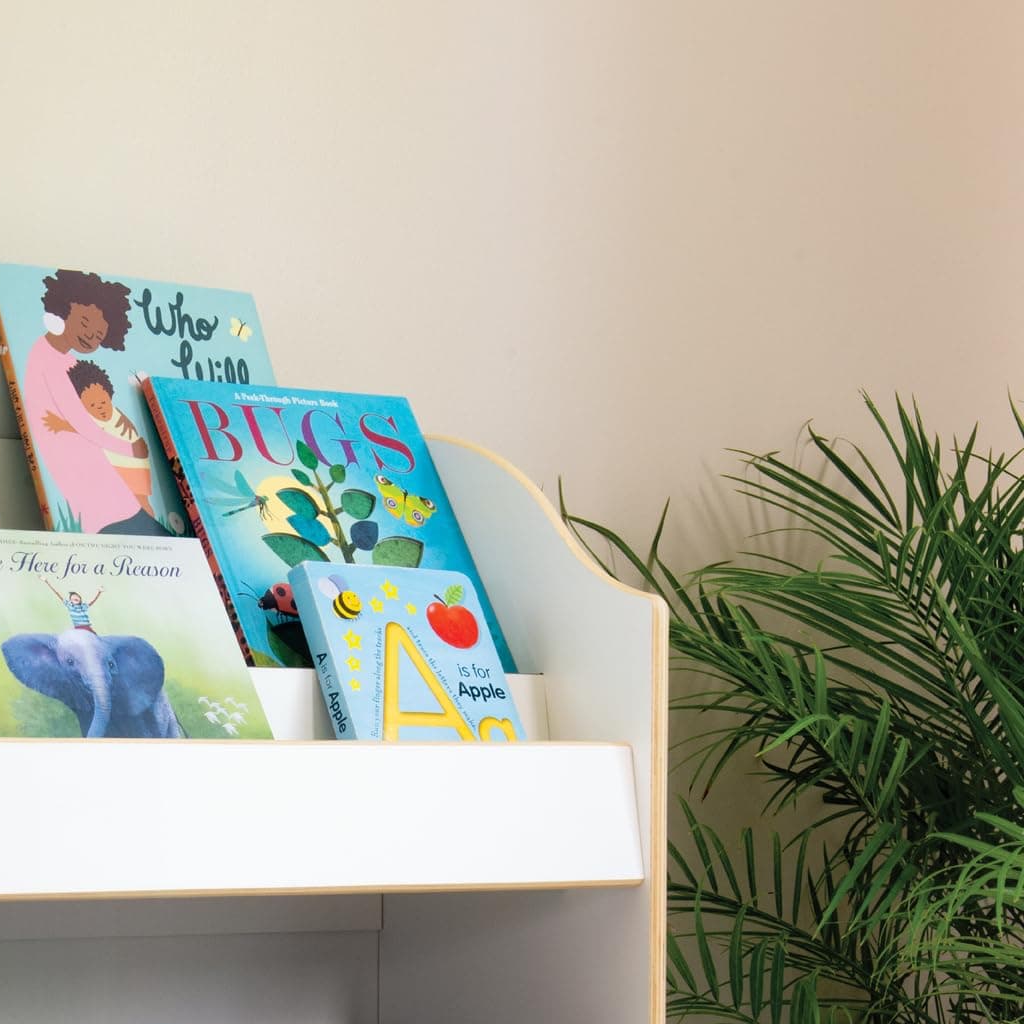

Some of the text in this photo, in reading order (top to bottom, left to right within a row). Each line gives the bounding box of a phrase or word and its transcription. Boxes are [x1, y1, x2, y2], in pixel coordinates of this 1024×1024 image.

[133, 288, 219, 341] Who
[170, 340, 250, 384] Will
[234, 392, 241, 400] A
[292, 396, 318, 407] Picture
[319, 399, 338, 408] Book
[178, 400, 416, 474] BUGS
[191, 517, 214, 560] BUGS
[10, 552, 59, 573] Here
[57, 554, 87, 579] for
[93, 562, 105, 575] a
[110, 555, 182, 578] Reason
[457, 663, 490, 679] is for
[459, 681, 506, 703] Apple
[316, 653, 348, 734] A is for Apple
